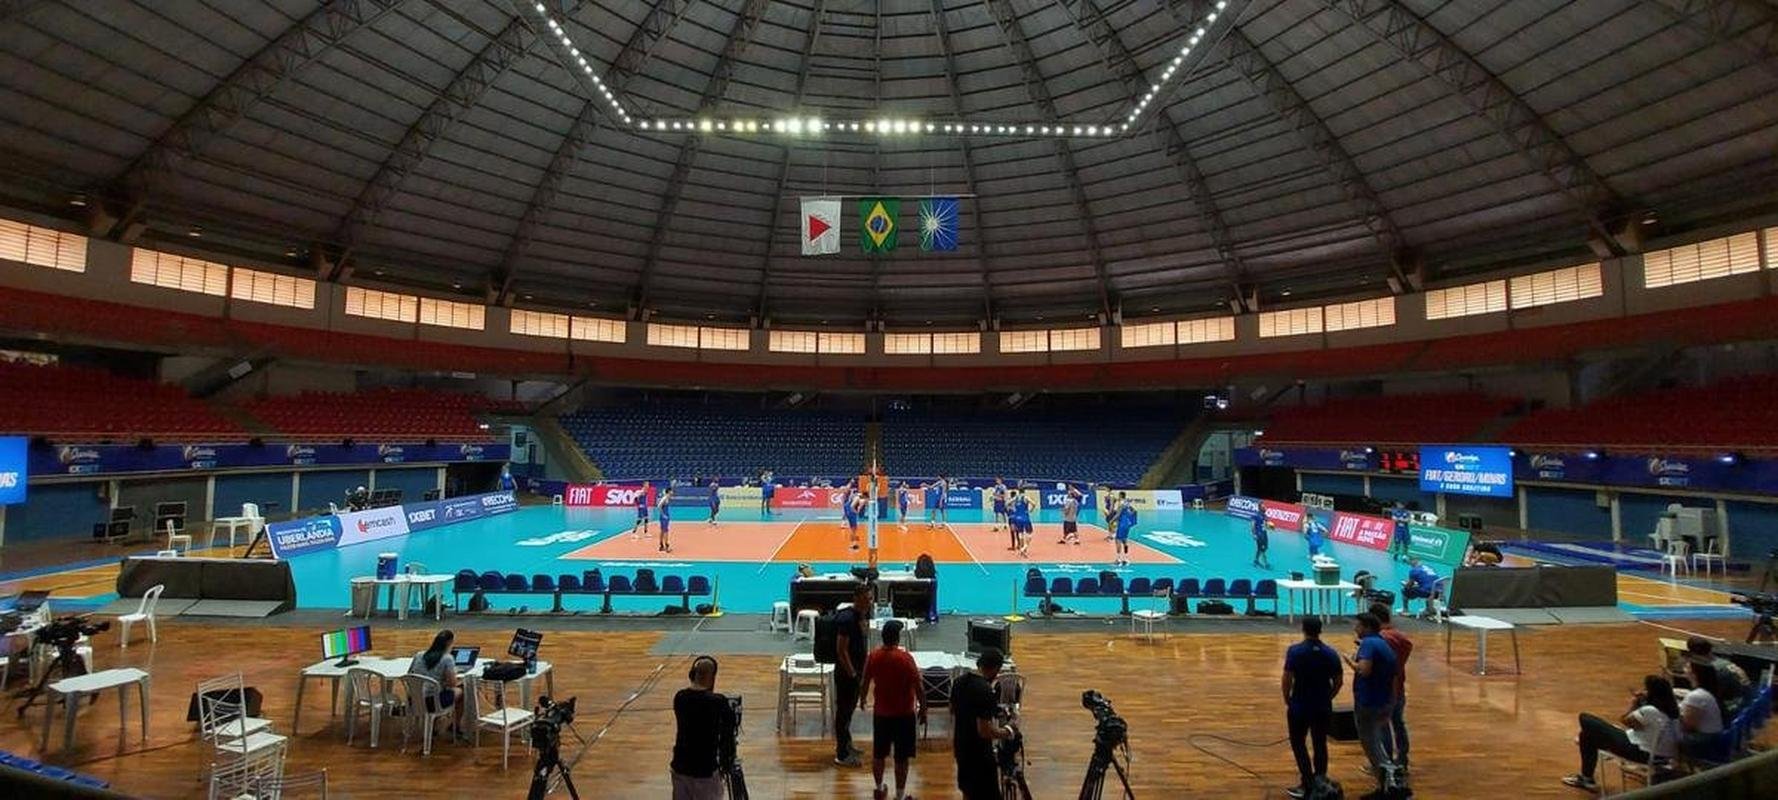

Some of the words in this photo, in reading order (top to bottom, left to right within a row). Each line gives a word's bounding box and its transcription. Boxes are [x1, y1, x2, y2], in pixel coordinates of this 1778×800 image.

[569, 488, 593, 505] FIAT
[1048, 494, 1089, 506] 1XT
[1334, 516, 1360, 540] FIAT
